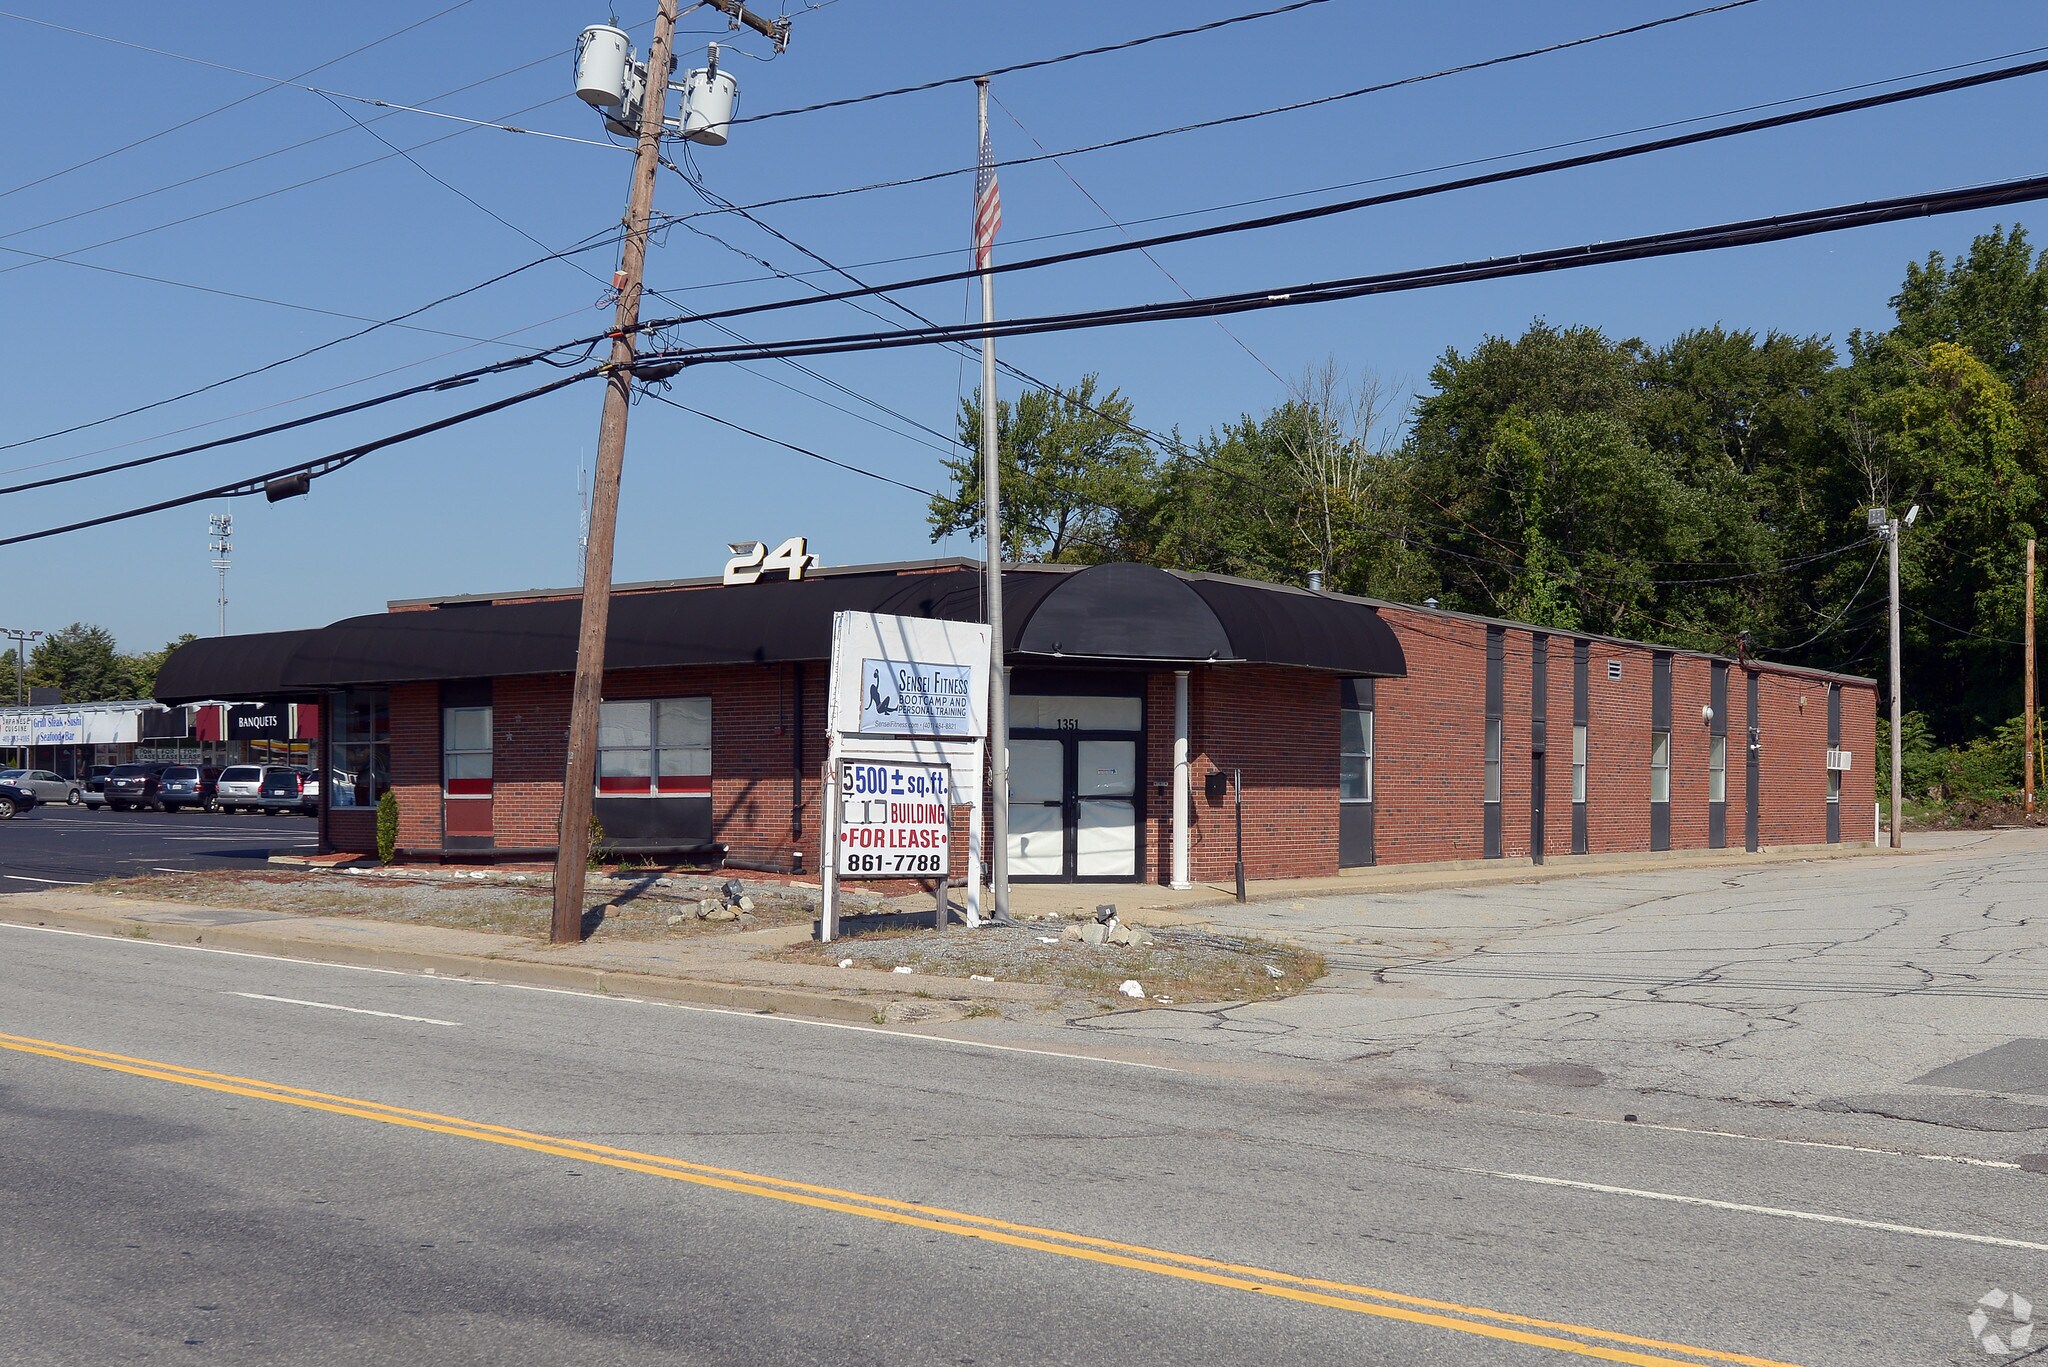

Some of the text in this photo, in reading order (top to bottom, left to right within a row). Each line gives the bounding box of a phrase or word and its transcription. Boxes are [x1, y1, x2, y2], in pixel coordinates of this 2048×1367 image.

[723, 537, 813, 586] 24
[899, 669, 969, 695] SENSEI FITNESS
[899, 694, 967, 707] BOOTCAMP AND
[898, 705, 967, 717] PERSONAL TRAINING
[5, 725, 27, 733] CUISINE
[238, 716, 278, 729] BANQUETS
[1057, 719, 1079, 730] 1351
[40, 731, 62, 741] Seafood
[65, 731, 75, 740] Bar
[891, 803, 945, 824] BUILDING
[849, 828, 940, 849] FOR LEASE
[847, 854, 941, 872] 861-7788
